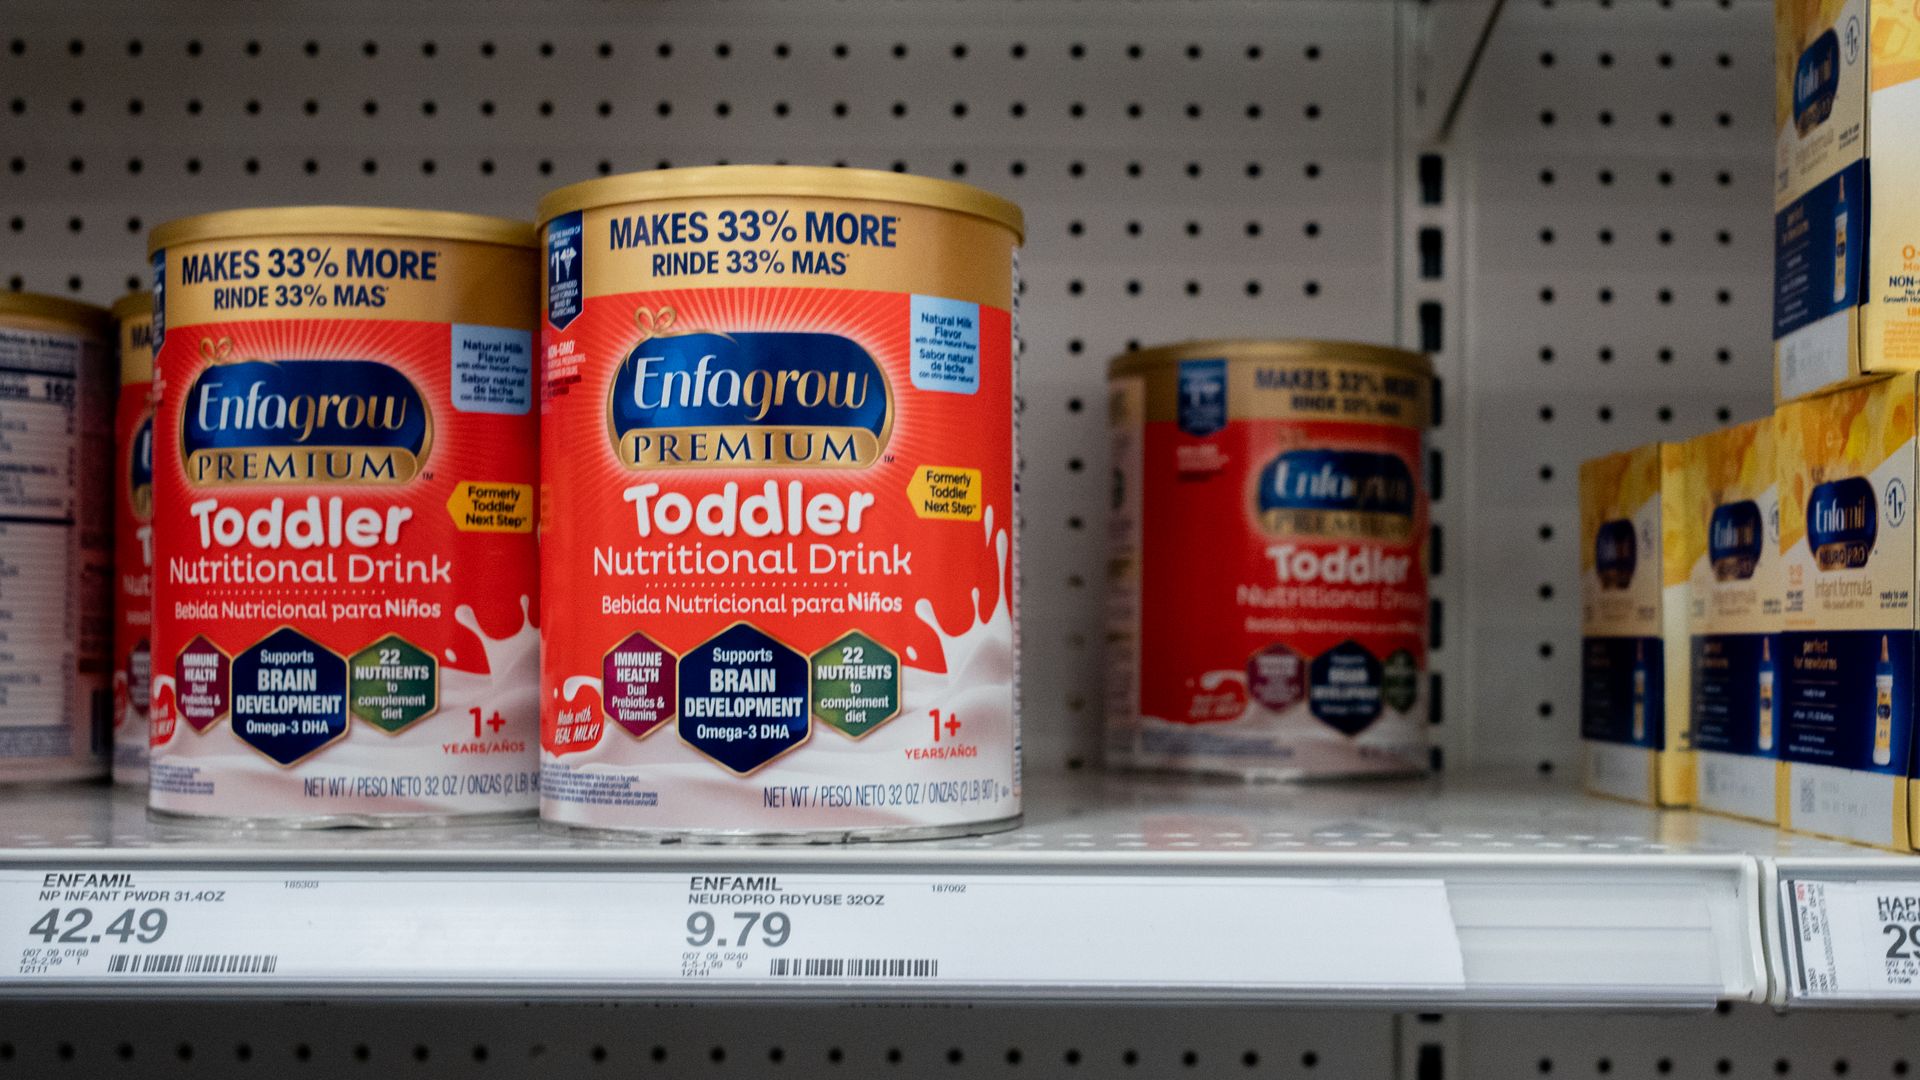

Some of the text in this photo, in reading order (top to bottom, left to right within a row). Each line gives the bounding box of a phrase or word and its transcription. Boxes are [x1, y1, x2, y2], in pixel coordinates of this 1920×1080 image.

[610, 209, 897, 250] MAKES 33% MORE
[182, 247, 437, 286] MAKES 33% MORE
[652, 250, 847, 278] RINDE 33% MAS
[214, 284, 386, 310] RINDE 33% MAS
[921, 312, 973, 329] Natural Milk
[934, 326, 962, 340] Flavor
[463, 339, 523, 354] Natural Milk
[478, 352, 510, 364] Flavor
[919, 348, 974, 365] Sabor natural
[931, 360, 965, 374] de leche
[461, 372, 525, 387] Sabor natural
[473, 385, 514, 396] de leche
[634, 353, 869, 423] Enfagrow
[198, 379, 409, 443] Enfagrow
[633, 433, 861, 464] PREMIUM
[197, 449, 397, 481] PREMIUM
[926, 470, 972, 488] Formerly
[468, 485, 520, 501] Formerly
[930, 485, 968, 499] Toddler
[472, 499, 516, 512] Toddler
[623, 479, 875, 538] Toddler
[924, 500, 974, 516] Next Step
[191, 496, 413, 549] Toddler
[466, 513, 522, 528] Next Step
[1816, 496, 1866, 535] Enfamil
[593, 543, 913, 577] Nutritional Drink
[1265, 545, 1411, 585] Toddler
[169, 553, 452, 585] Nutritional Drink
[1236, 583, 1379, 609] Nutritional
[175, 599, 441, 622] Bebida Nutricional para Niños
[602, 592, 903, 618] Bebida Nutricional para Niños
[183, 653, 219, 668] IMMUNE
[260, 649, 314, 666] Supports
[379, 649, 400, 665] 22
[613, 651, 662, 668] IMMUNE
[712, 647, 773, 665] Supports
[842, 647, 864, 663] 22
[184, 668, 217, 682] HEALTH
[257, 669, 317, 691] BRAIN
[355, 665, 430, 681] NUTRIENTS
[616, 667, 659, 683] HEALTH
[817, 664, 892, 680] NUTRIENTS
[386, 681, 398, 692] to
[709, 668, 776, 693] BRAIN
[850, 681, 861, 694] to
[627, 684, 648, 696] Dual
[236, 695, 342, 714] DEVELOPMENT
[358, 695, 426, 707] complement
[612, 695, 665, 709] Prebiotics &
[684, 696, 803, 718] DEVELOPMENT
[820, 695, 889, 711] complement
[381, 707, 403, 720] diet
[618, 708, 657, 722] Vitamins
[845, 710, 867, 724] diet
[246, 720, 329, 737] Omega-3 DHA
[469, 706, 506, 738] 1+
[928, 708, 962, 742] 1+
[696, 723, 790, 743] Omega-3 DHA
[442, 740, 526, 755] YEARS/AÑOS
[904, 744, 978, 760] YEARS/AÑOS
[304, 777, 326, 798] NET
[328, 777, 346, 797] WT
[350, 778, 355, 797] /
[357, 777, 388, 797] PESO
[391, 776, 421, 797] NETO
[425, 775, 439, 796] 32
[442, 775, 458, 795] OZ
[459, 775, 465, 795] /
[467, 773, 501, 794] ONZAS
[763, 786, 787, 808] NET
[790, 786, 809, 807] WT
[812, 787, 817, 808] /
[821, 786, 852, 808] PESO
[855, 785, 885, 807] NETO
[888, 784, 902, 806] 32
[905, 783, 920, 805] OZ
[921, 783, 926, 803] /
[929, 780, 959, 803] ONZAS
[42, 873, 136, 889] ENFAMIL
[690, 877, 783, 891] ENFAMIL
[39, 890, 226, 902] NP INFANT PWDR 31.4OZ
[688, 893, 886, 906] NEUROPRO RDYUSE 32OZ
[1877, 896, 1920, 911] HAP
[1879, 911, 1920, 922] STAG
[28, 907, 168, 944] 42.49
[686, 911, 791, 948] 9.79
[22, 949, 42, 957] 007
[682, 952, 701, 961] 007
